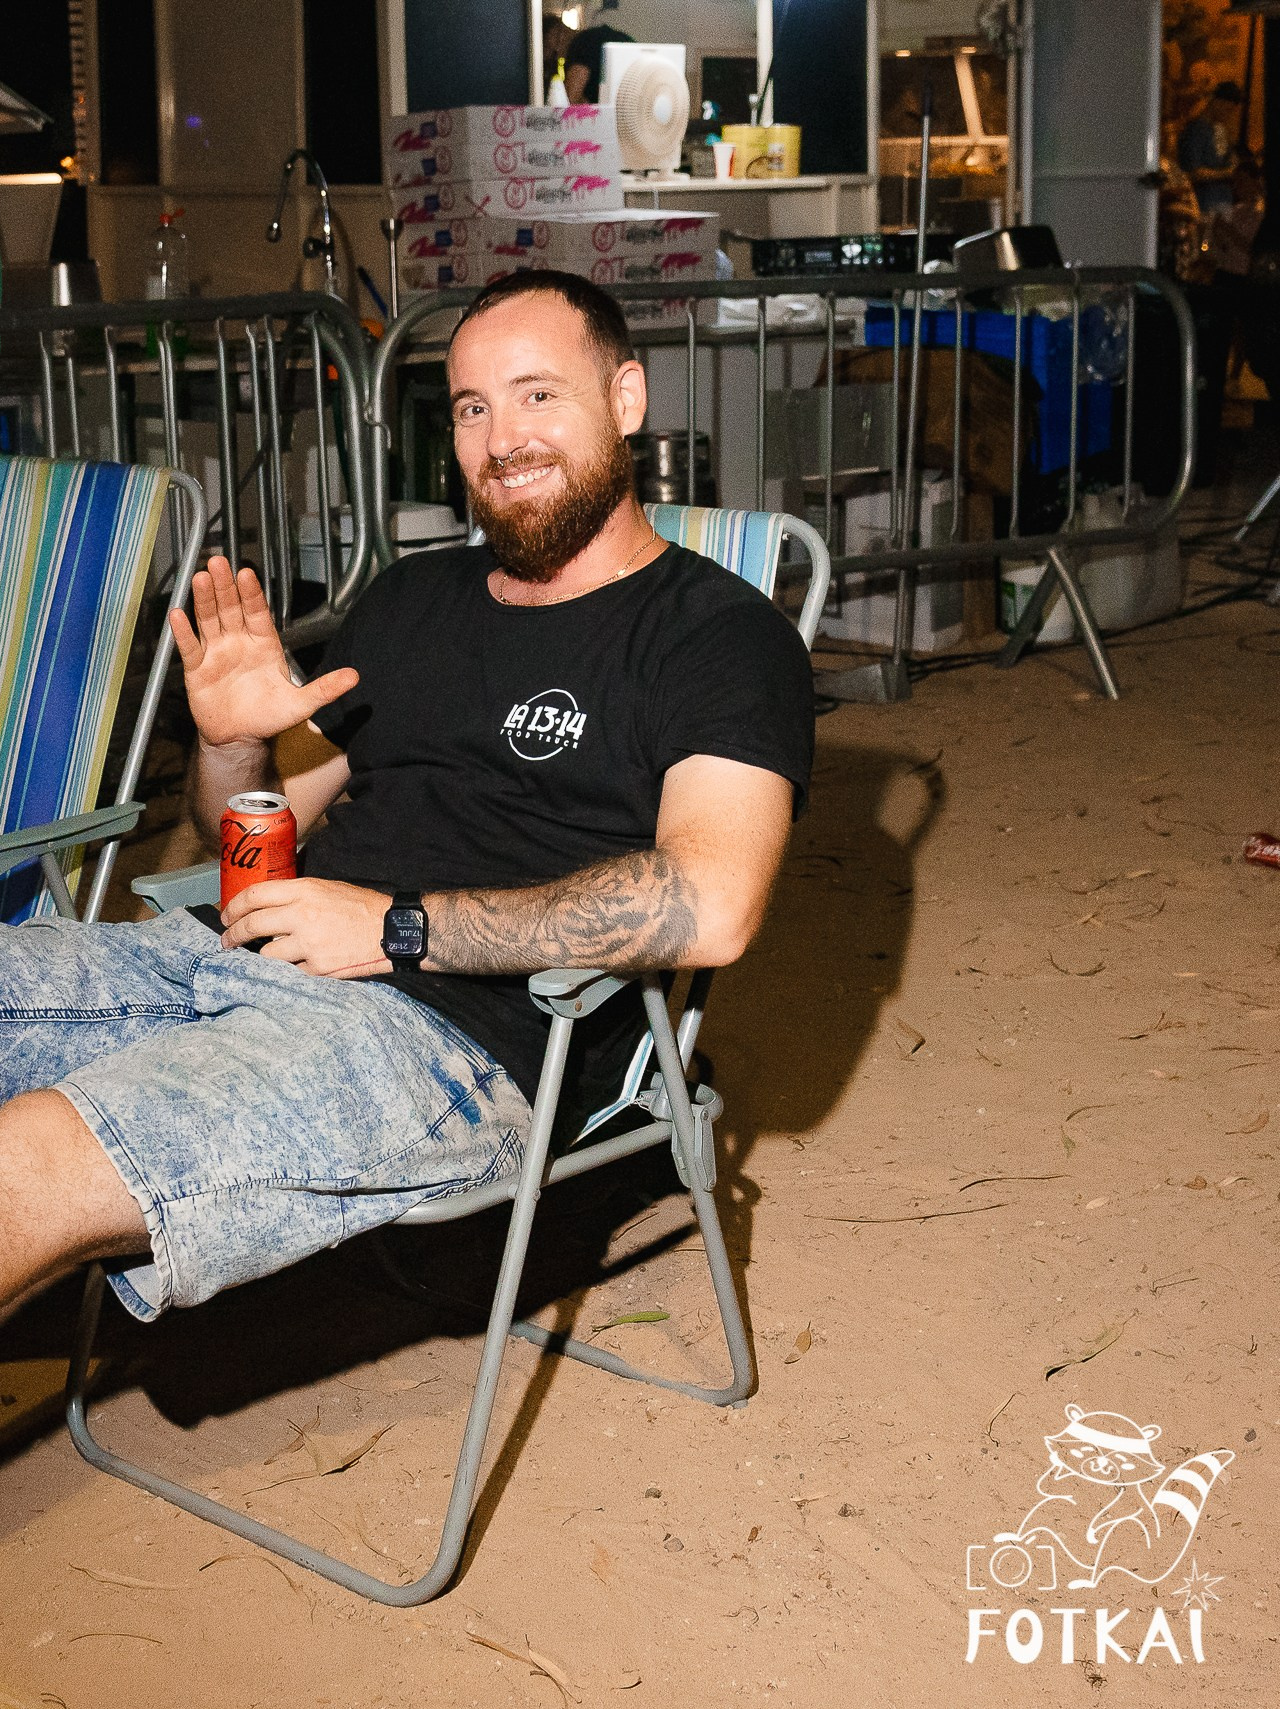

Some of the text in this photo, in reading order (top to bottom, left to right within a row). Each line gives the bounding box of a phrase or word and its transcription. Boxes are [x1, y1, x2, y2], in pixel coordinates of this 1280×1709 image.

[503, 703, 530, 729] LA
[499, 728, 579, 749] FOOD TRUCK
